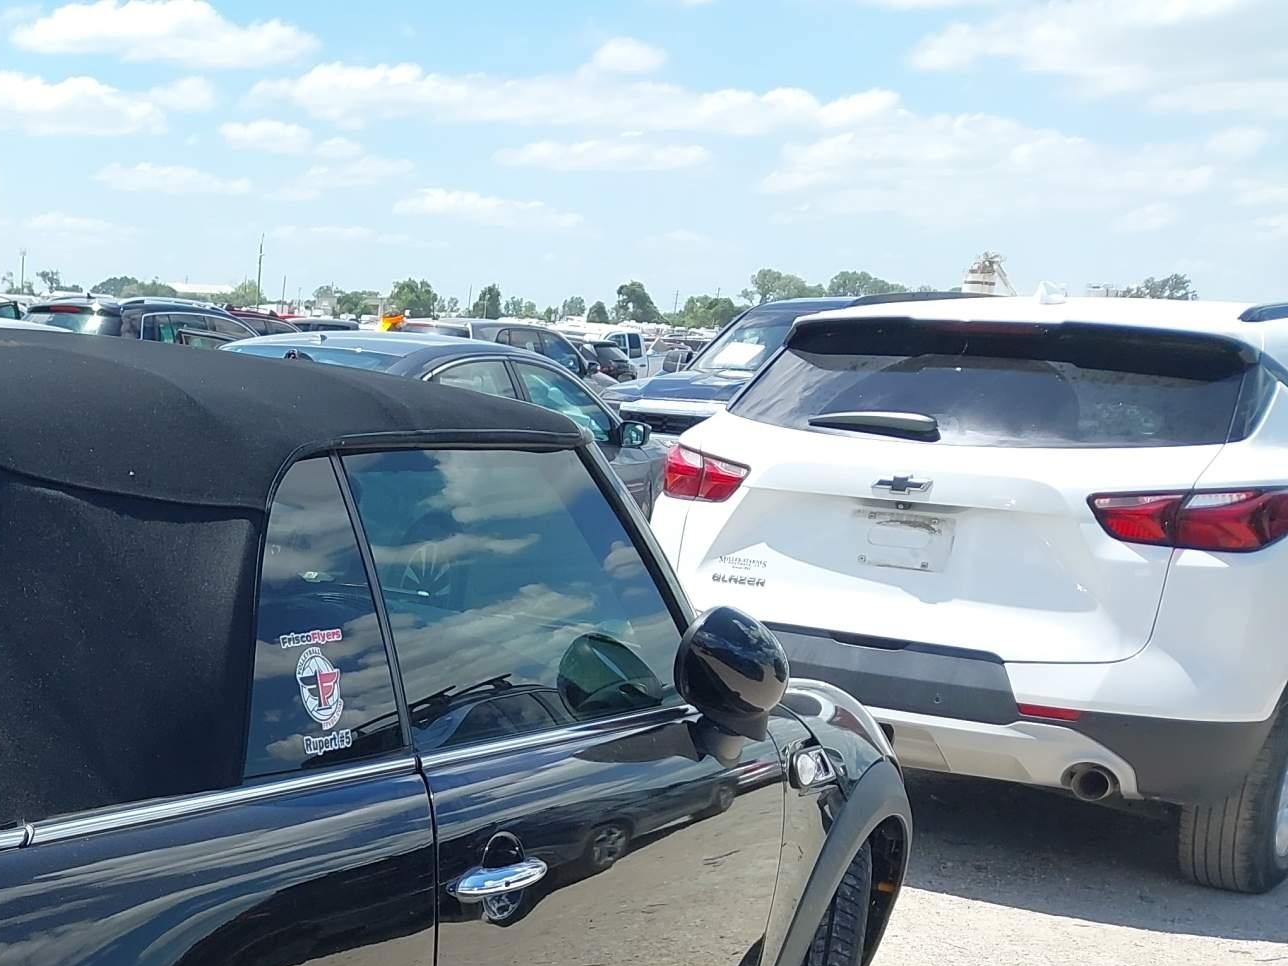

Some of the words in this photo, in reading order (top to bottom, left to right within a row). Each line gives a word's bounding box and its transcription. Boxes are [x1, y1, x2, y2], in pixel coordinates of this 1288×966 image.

[281, 629, 342, 647] FriscoFlyers
[305, 735, 337, 754] Rupert
[339, 732, 351, 748] #5
